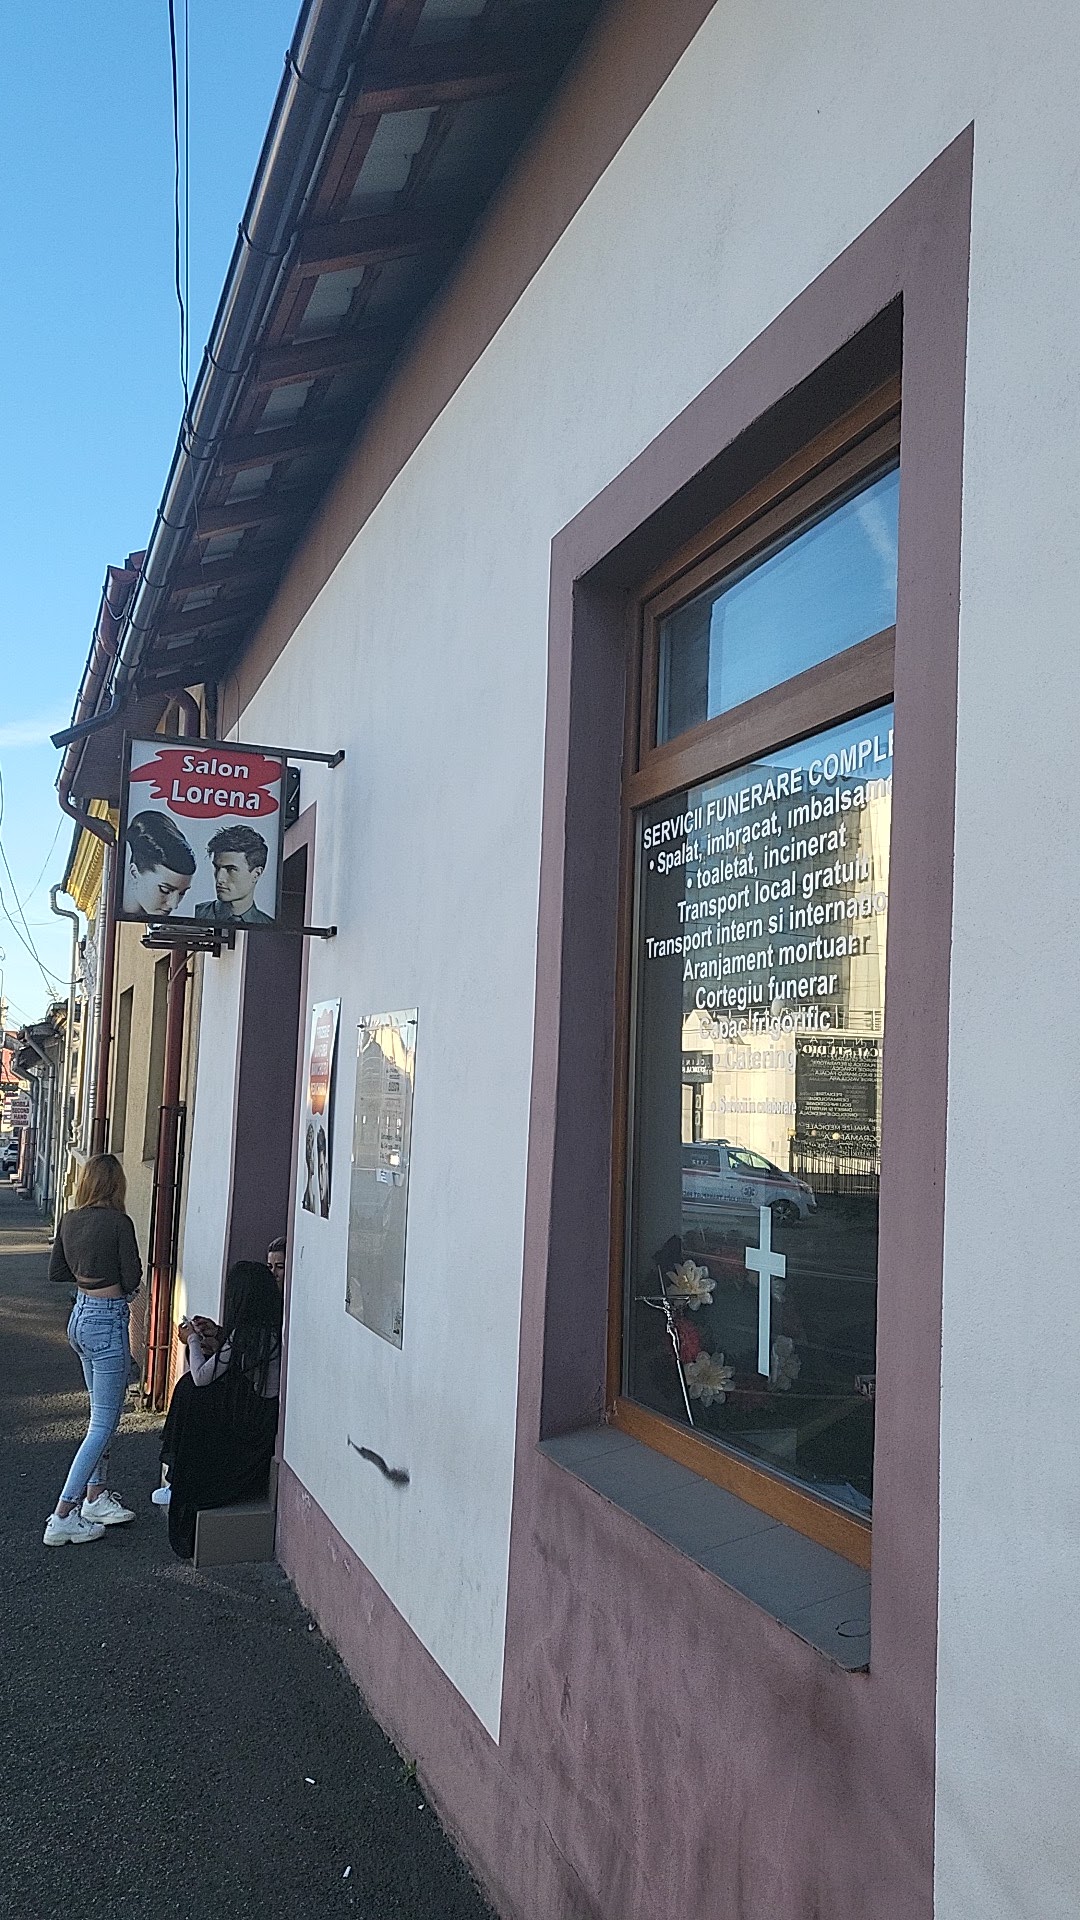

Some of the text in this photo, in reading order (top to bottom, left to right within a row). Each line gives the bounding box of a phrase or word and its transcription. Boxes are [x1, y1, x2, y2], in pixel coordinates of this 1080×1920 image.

[181, 755, 249, 778] Salon
[171, 779, 260, 810] Lorena
[643, 807, 703, 850] SERVICII
[706, 768, 803, 826] FUNERARE
[657, 839, 703, 875] Spalat,
[707, 812, 783, 856] imbracat,
[697, 822, 847, 889] toaletat, incinerat
[677, 857, 870, 923] Transport local gratuit
[645, 925, 713, 959] Transport
[716, 918, 763, 945] intern
[768, 907, 784, 935] si
[682, 934, 862, 982] Aranjament mortuar
[695, 974, 838, 1011] Cortegiu funerar
[751, 1004, 832, 1041] frigorific
[725, 1046, 796, 1075] Catering
